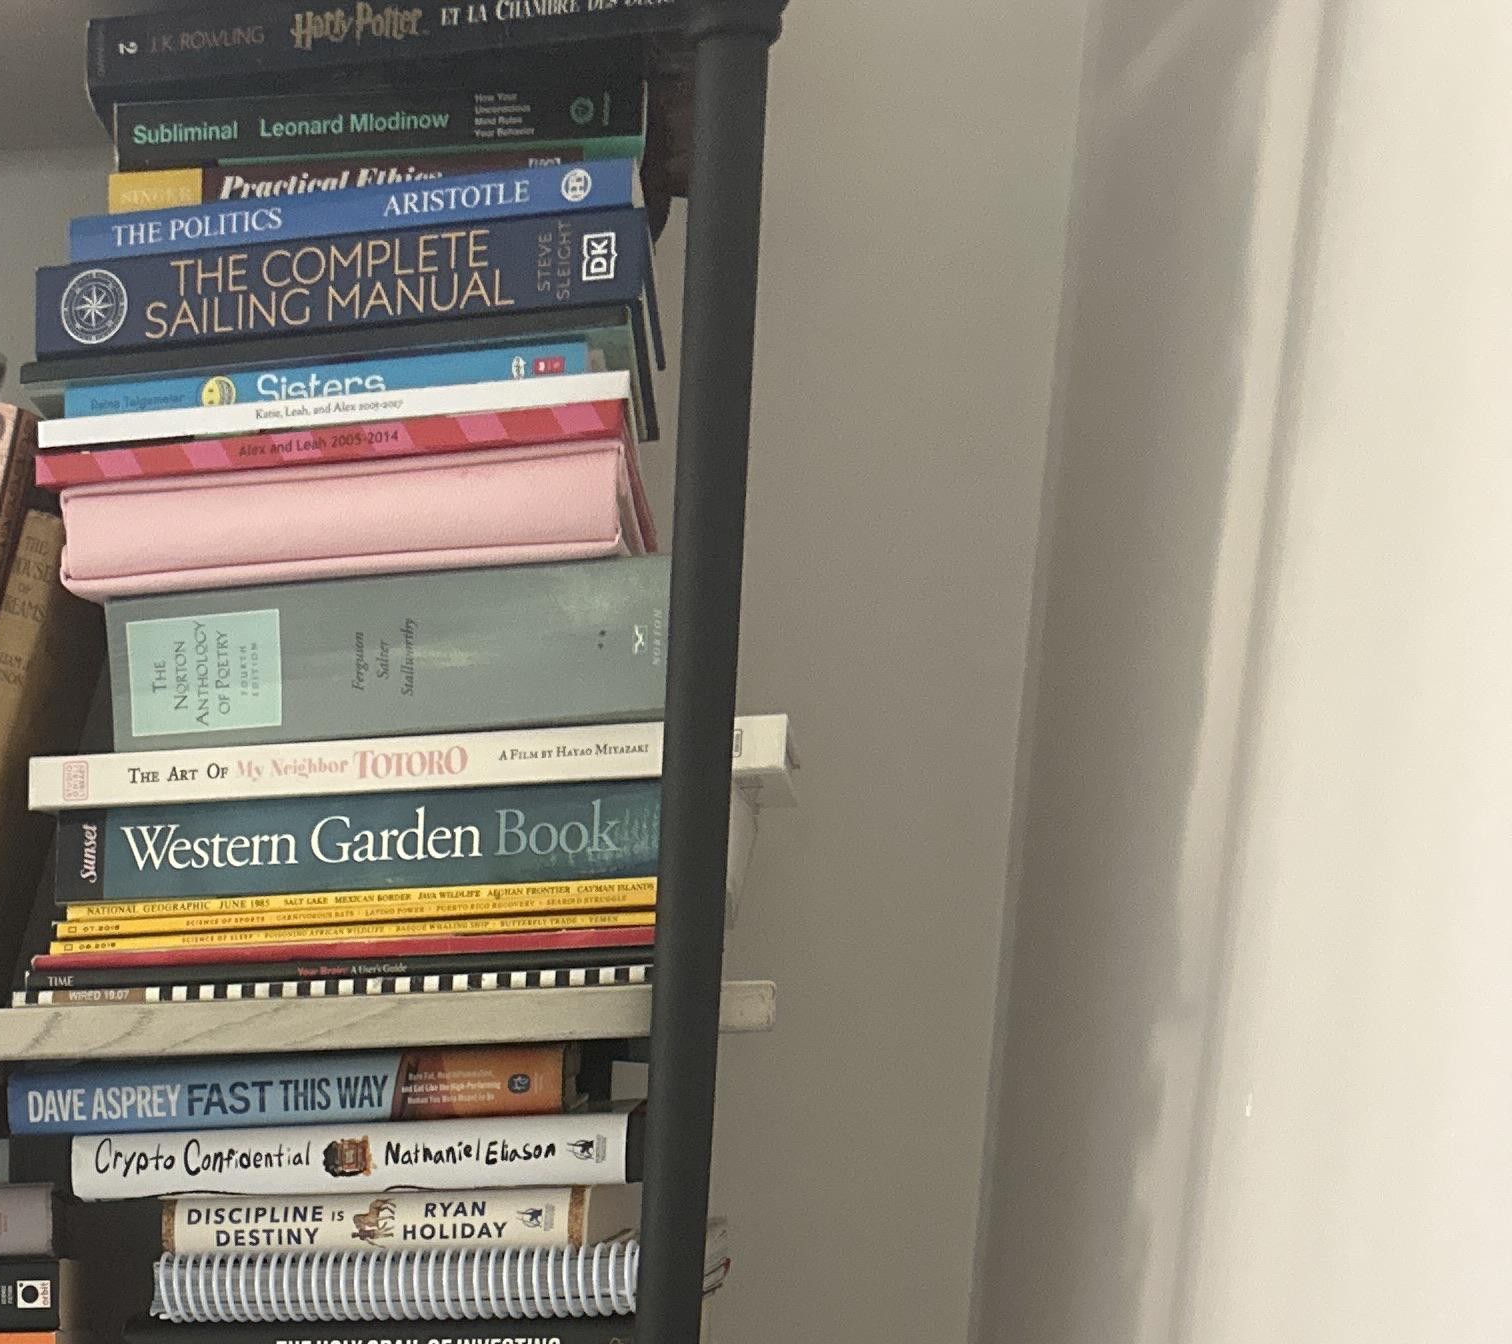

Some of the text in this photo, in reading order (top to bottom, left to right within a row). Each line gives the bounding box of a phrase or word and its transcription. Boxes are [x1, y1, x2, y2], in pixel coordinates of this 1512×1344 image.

[133, 111, 449, 145] Subliminal Leonard Mlodinow
[112, 182, 530, 248] THE POLITICS ARISTOTLE
[171, 230, 490, 298] THE COMPLETE
[144, 272, 514, 339] SAILING MANUAL
[128, 745, 468, 785] THE ART OF My Neighbor TOTORO
[80, 824, 98, 884] Sunset
[121, 801, 619, 872] Western Garden Book
[87, 899, 270, 916] NATIONAL GEOGRAPHIC JUNE 1985
[47, 976, 74, 987] TIME
[27, 1074, 388, 1123] DAVE ASPREY FAST THIS WAY
